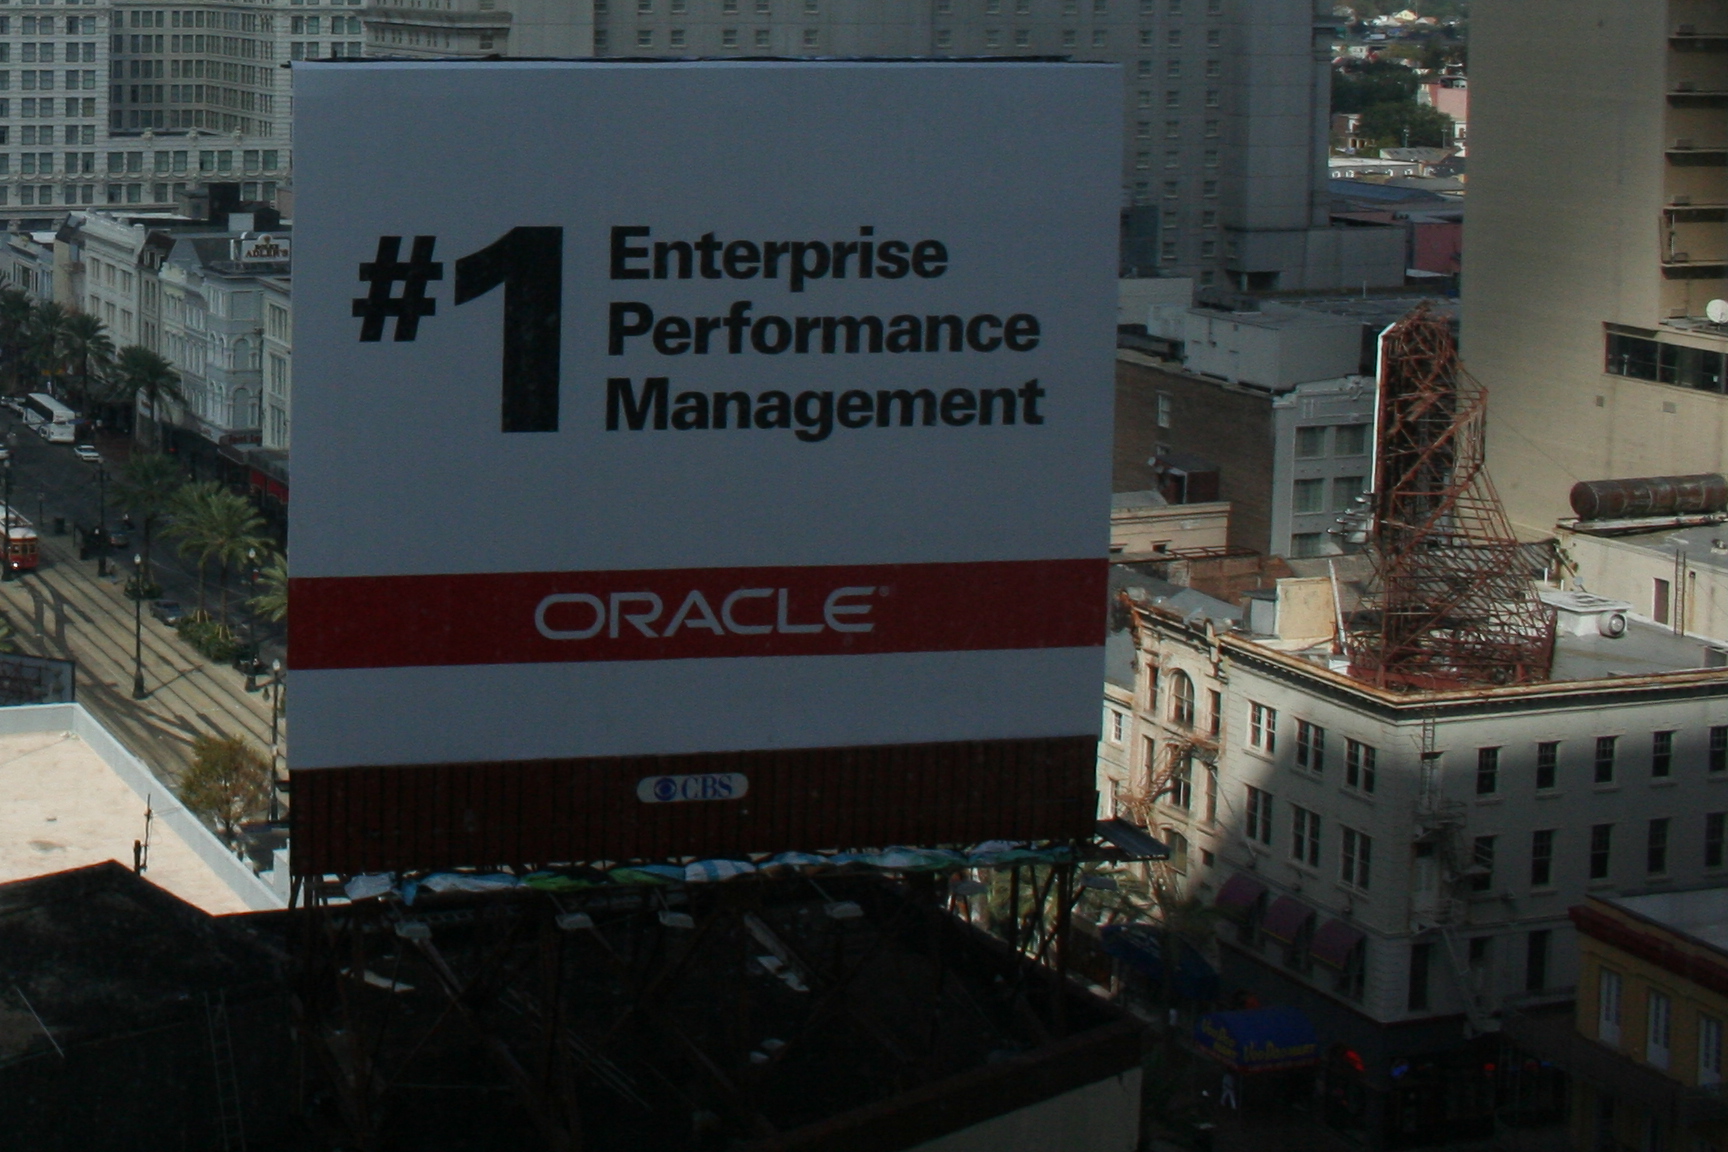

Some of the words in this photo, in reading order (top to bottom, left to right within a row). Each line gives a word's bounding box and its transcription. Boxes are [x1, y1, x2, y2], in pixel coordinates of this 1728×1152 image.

[609, 225, 949, 293] Enterprise
[351, 225, 564, 434] #1
[608, 300, 1041, 357] Performance
[605, 376, 1046, 443] Management
[534, 586, 878, 640] ORACLE
[681, 774, 733, 800] CBS
